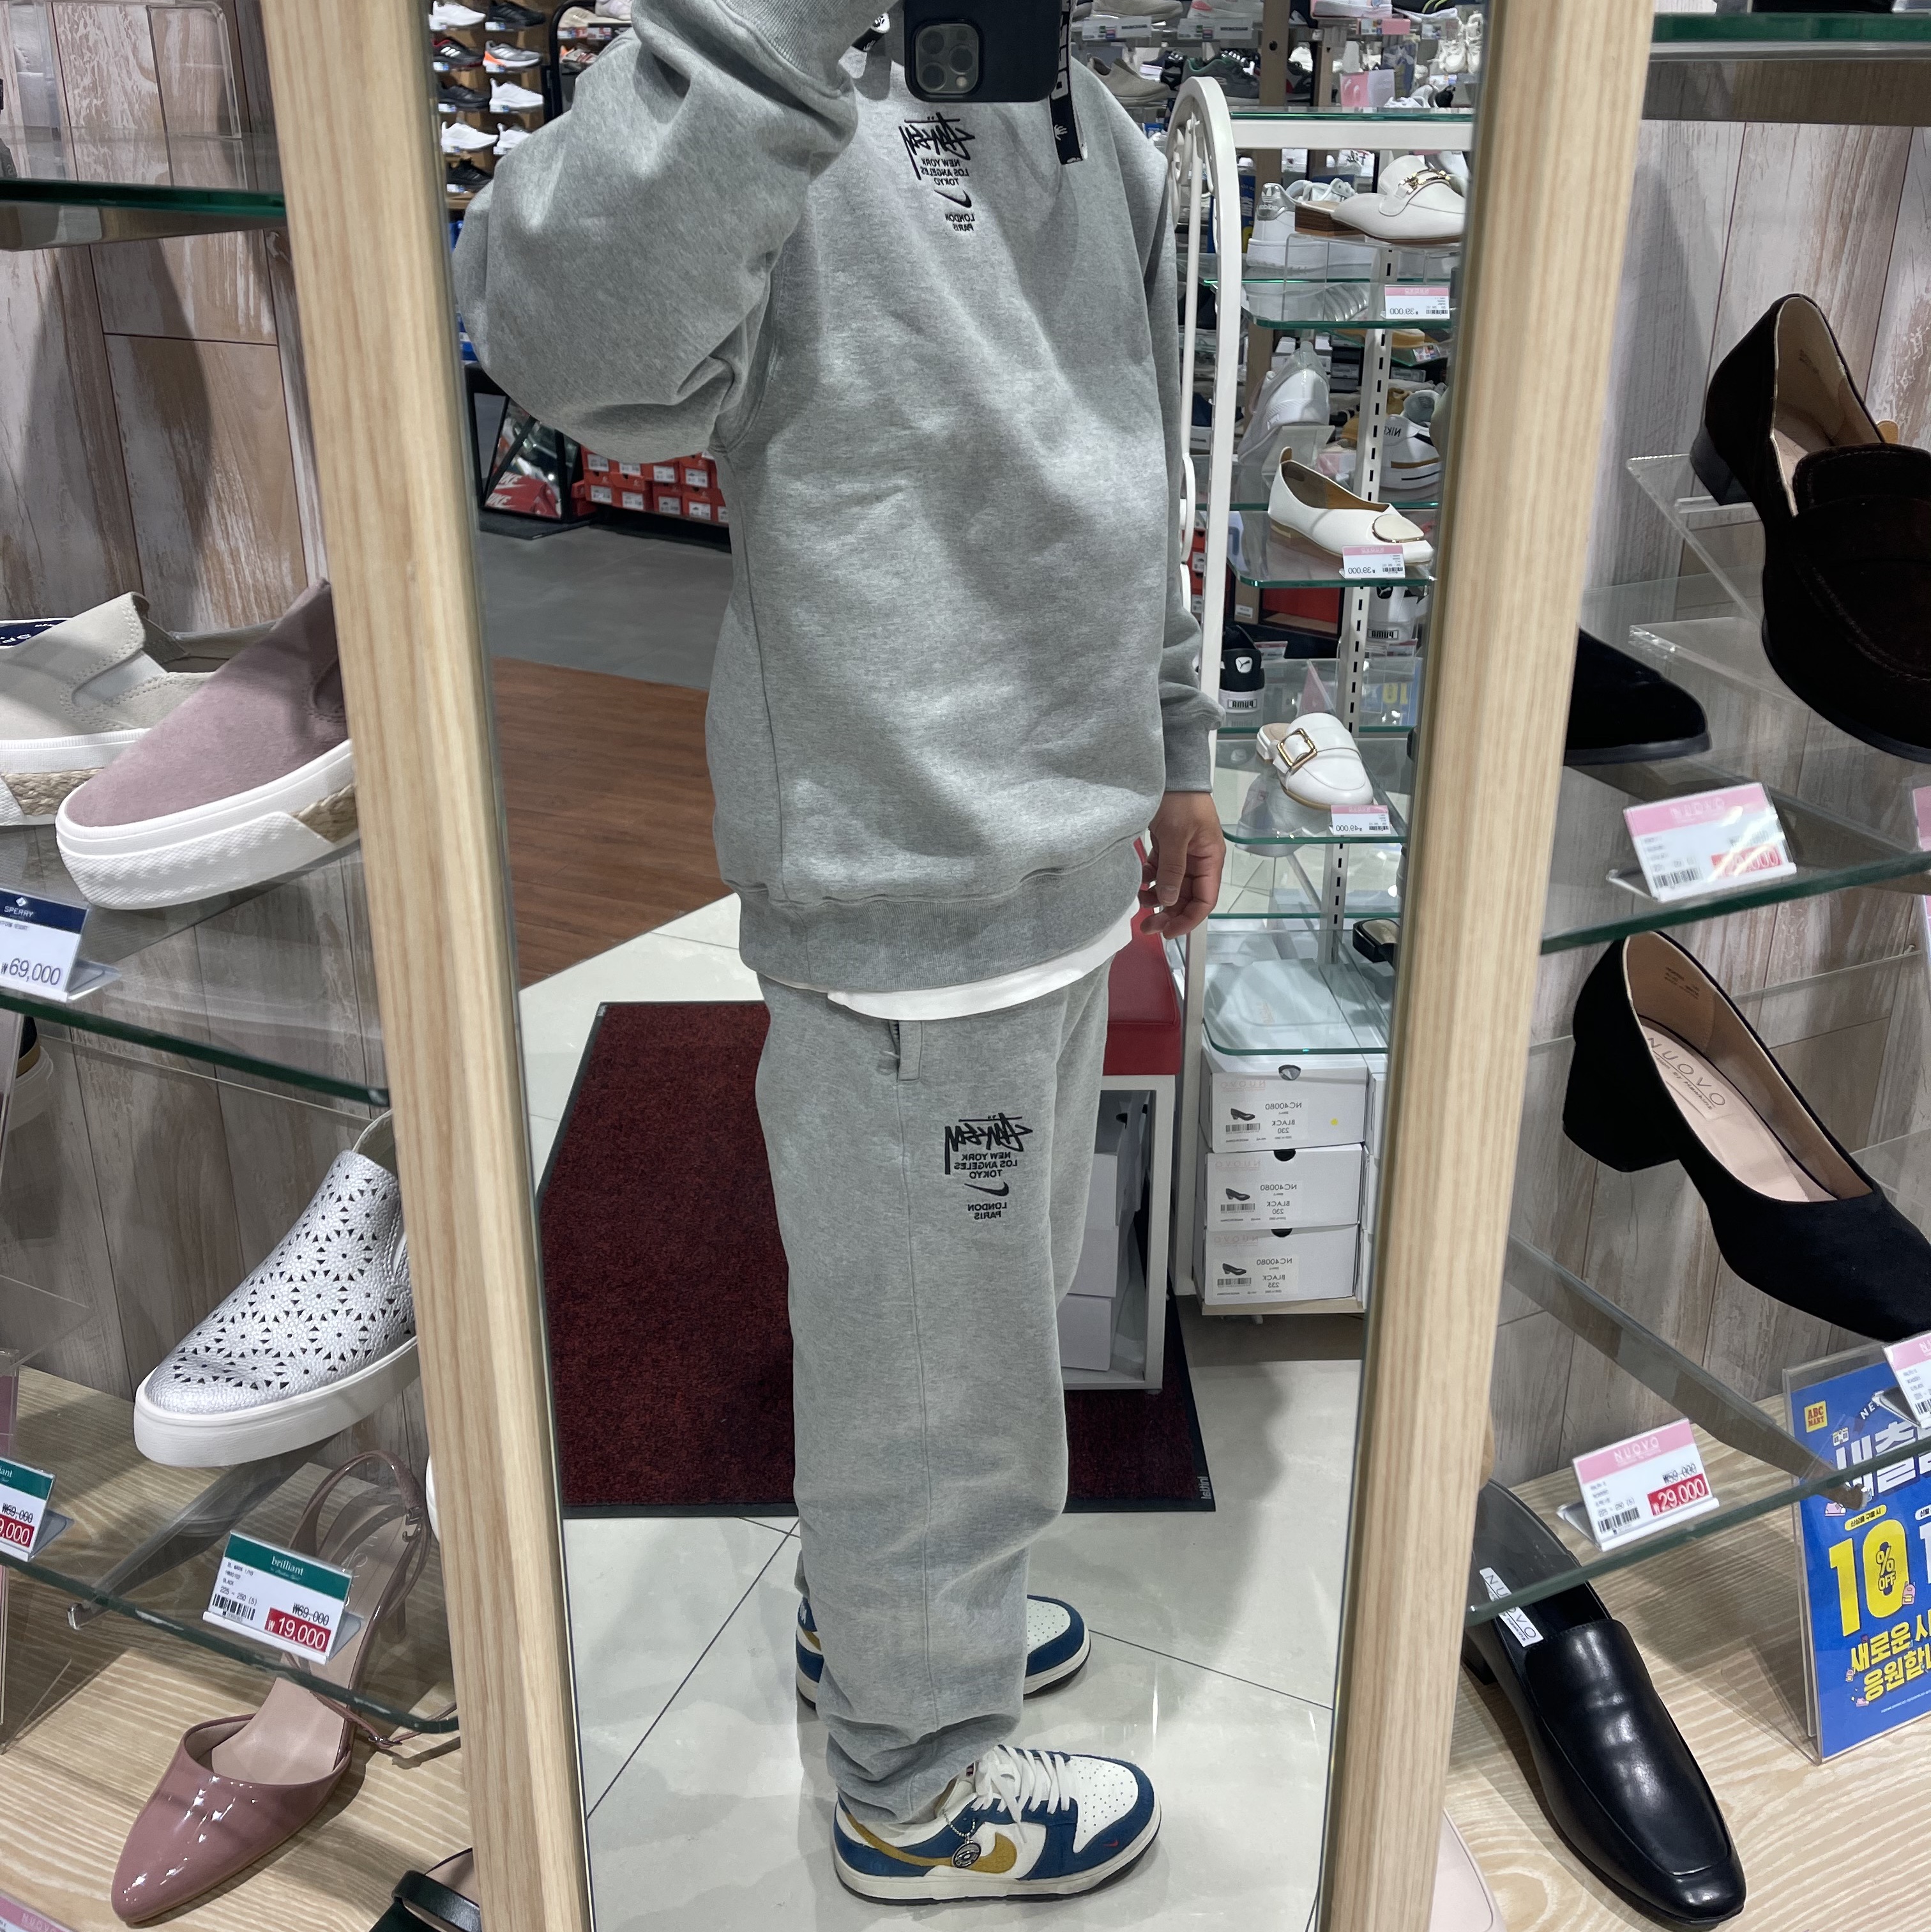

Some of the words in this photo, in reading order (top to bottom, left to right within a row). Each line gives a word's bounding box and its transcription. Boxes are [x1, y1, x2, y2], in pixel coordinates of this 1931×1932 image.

[4, 906, 34, 918] SPERRY
[1647, 1037, 1725, 1105] NUOVO
[1808, 1406, 1824, 1419] ABC
[1808, 1416, 1824, 1427] MART
[1614, 1436, 1660, 1462] NUOVO
[271, 1556, 304, 1576] brilliant
[1829, 1519, 1910, 1637] 10
[1878, 1571, 1897, 1592] OFF
[1851, 1622, 1912, 1674] 새로운
